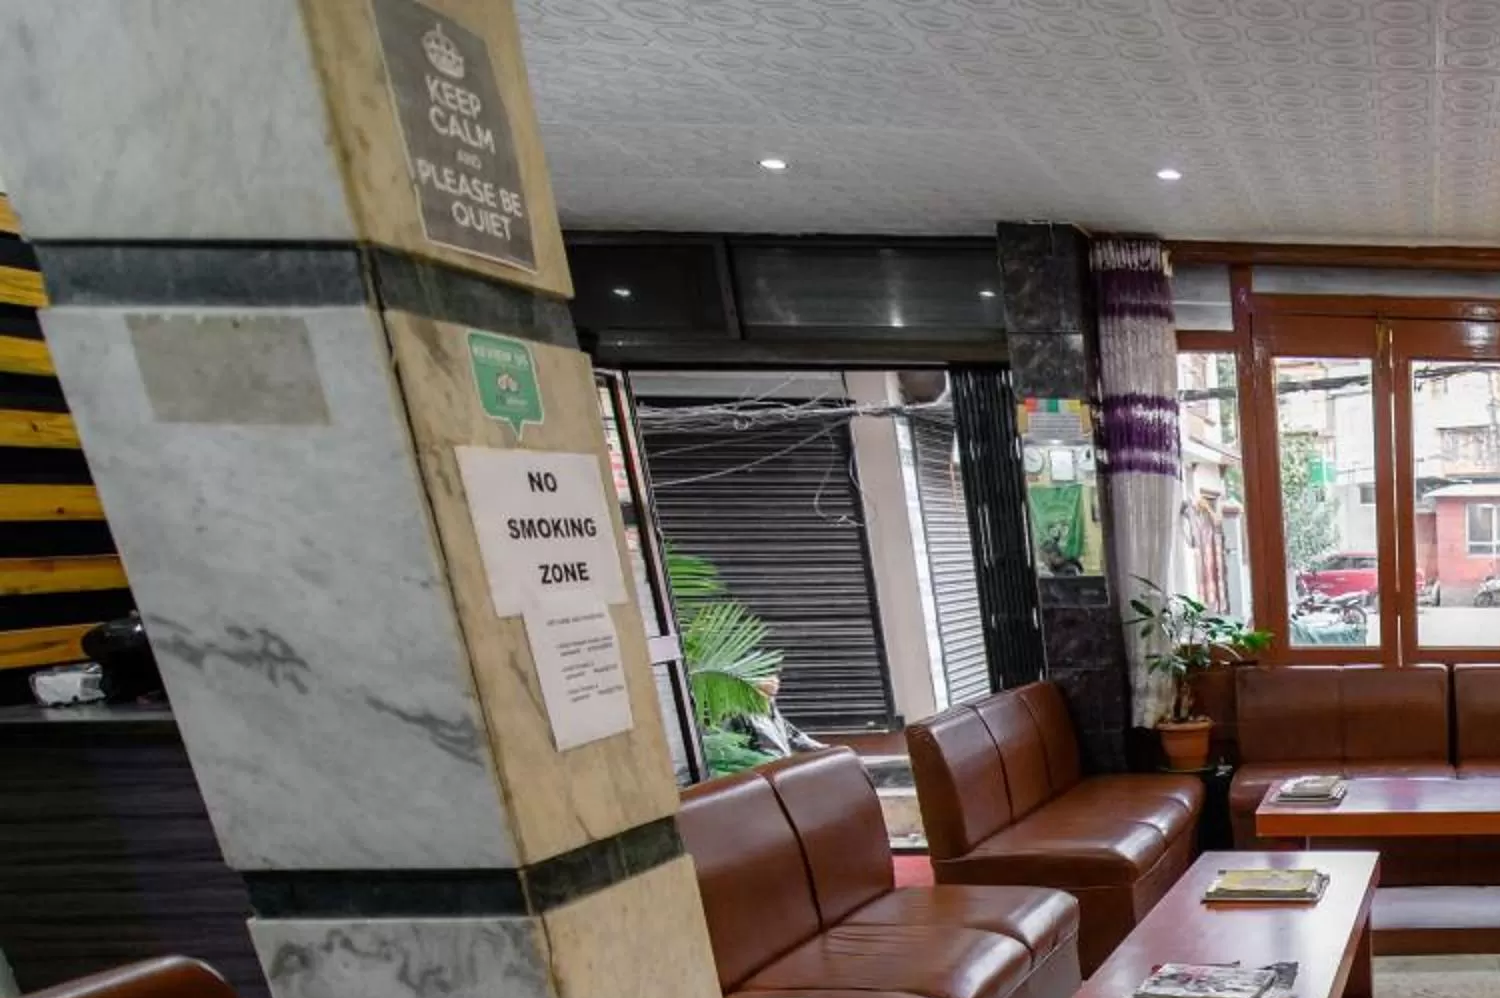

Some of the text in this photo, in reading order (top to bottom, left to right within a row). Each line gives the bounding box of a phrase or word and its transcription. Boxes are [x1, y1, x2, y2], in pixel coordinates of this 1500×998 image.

[425, 74, 482, 120] KEEP
[428, 105, 496, 155] CALM
[456, 149, 482, 170] AND
[416, 158, 523, 218] PLEASE BE
[451, 200, 512, 241] QUIET
[526, 470, 558, 494] NO
[506, 516, 597, 540] SMOKING
[538, 561, 590, 585] ZONE
